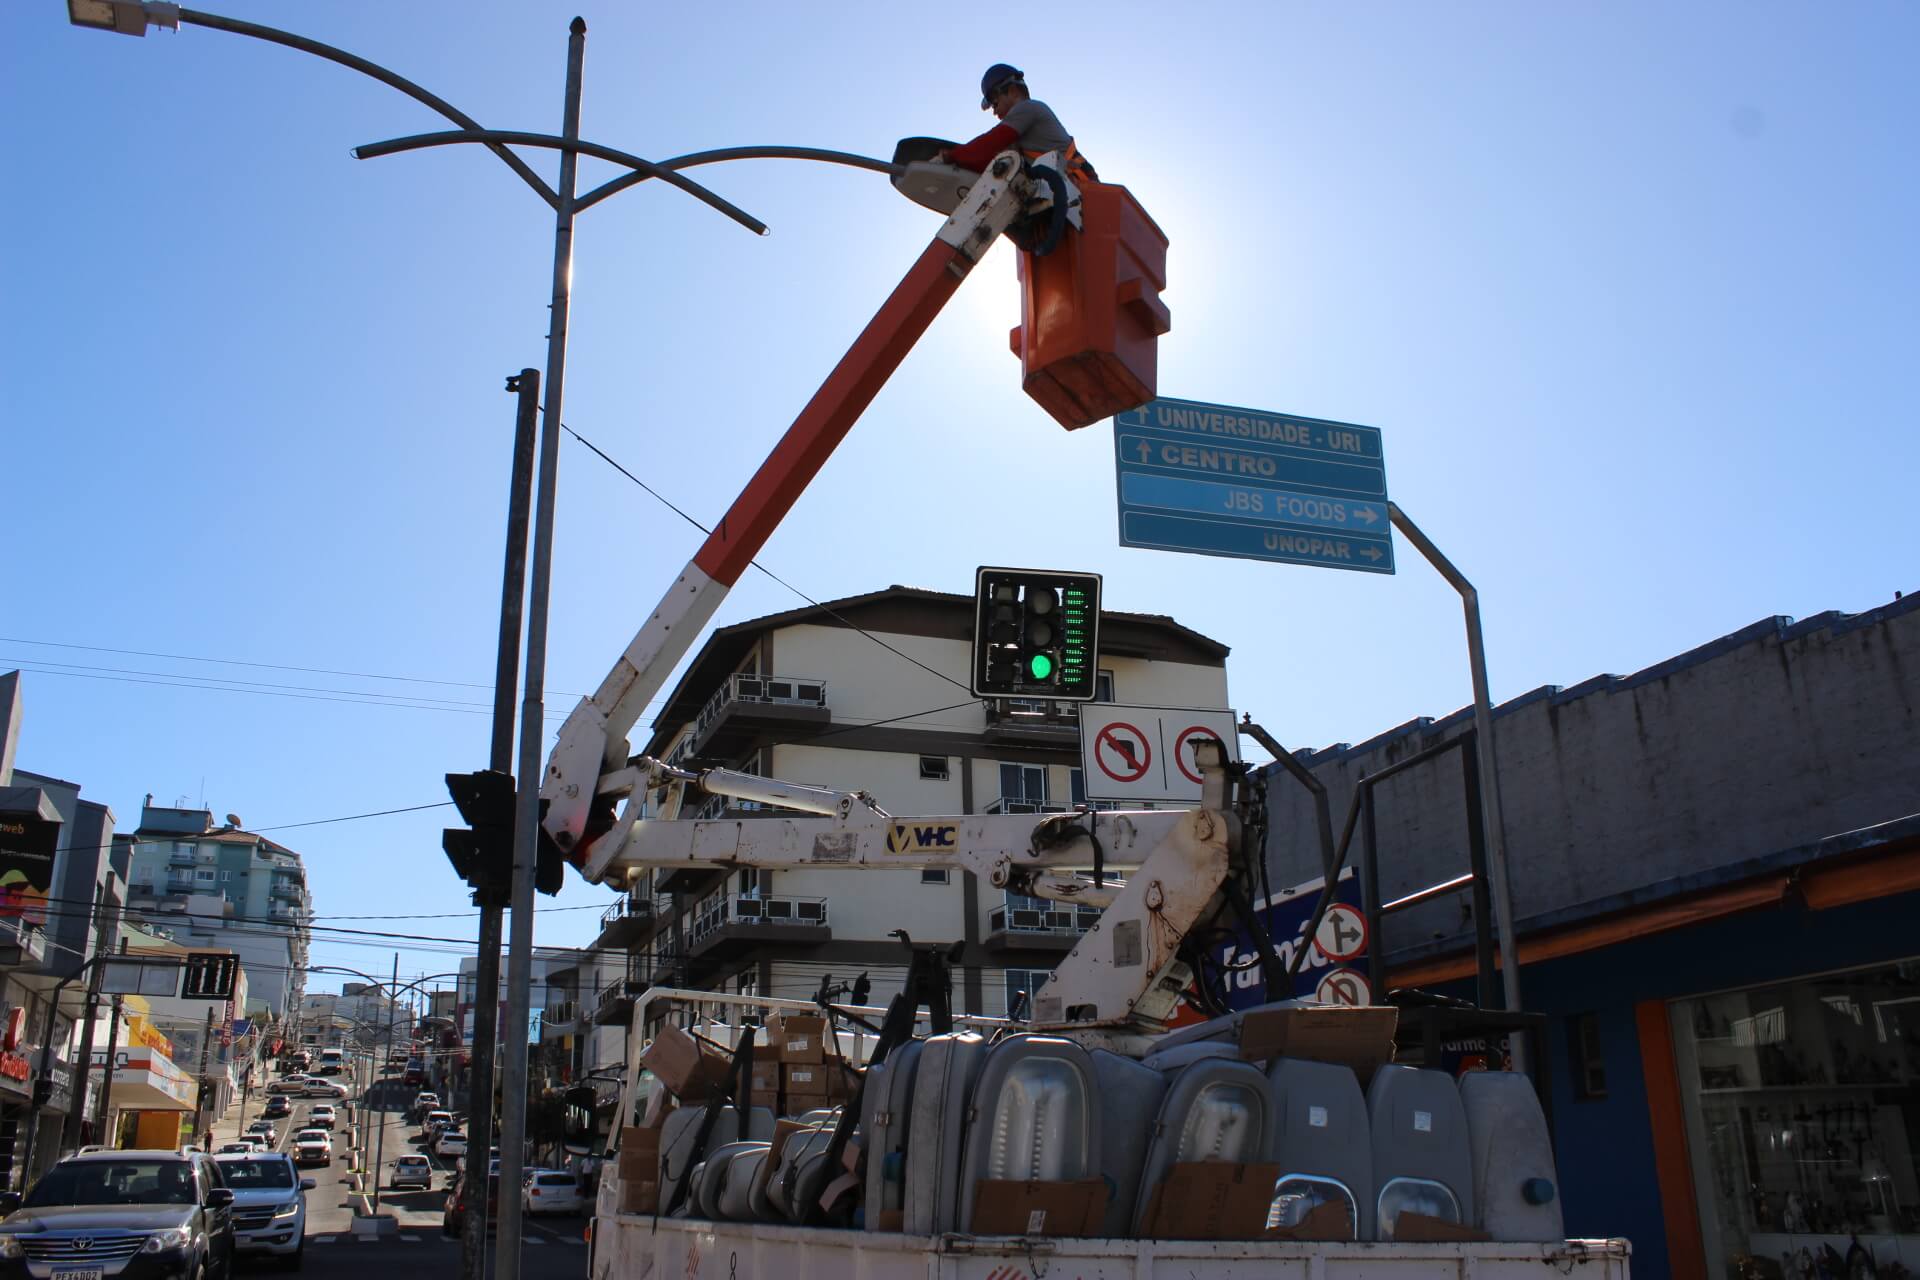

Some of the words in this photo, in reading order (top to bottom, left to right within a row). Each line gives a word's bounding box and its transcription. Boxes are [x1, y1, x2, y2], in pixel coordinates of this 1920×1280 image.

[1157, 407, 1310, 445] UNIVERSIDADE
[1328, 431, 1361, 452] URI
[1161, 445, 1277, 476] CENTRO
[1224, 490, 1264, 512] JBS
[1276, 496, 1346, 522] FOODS
[1263, 533, 1350, 559] UNOPAR
[913, 826, 956, 847] VHC
